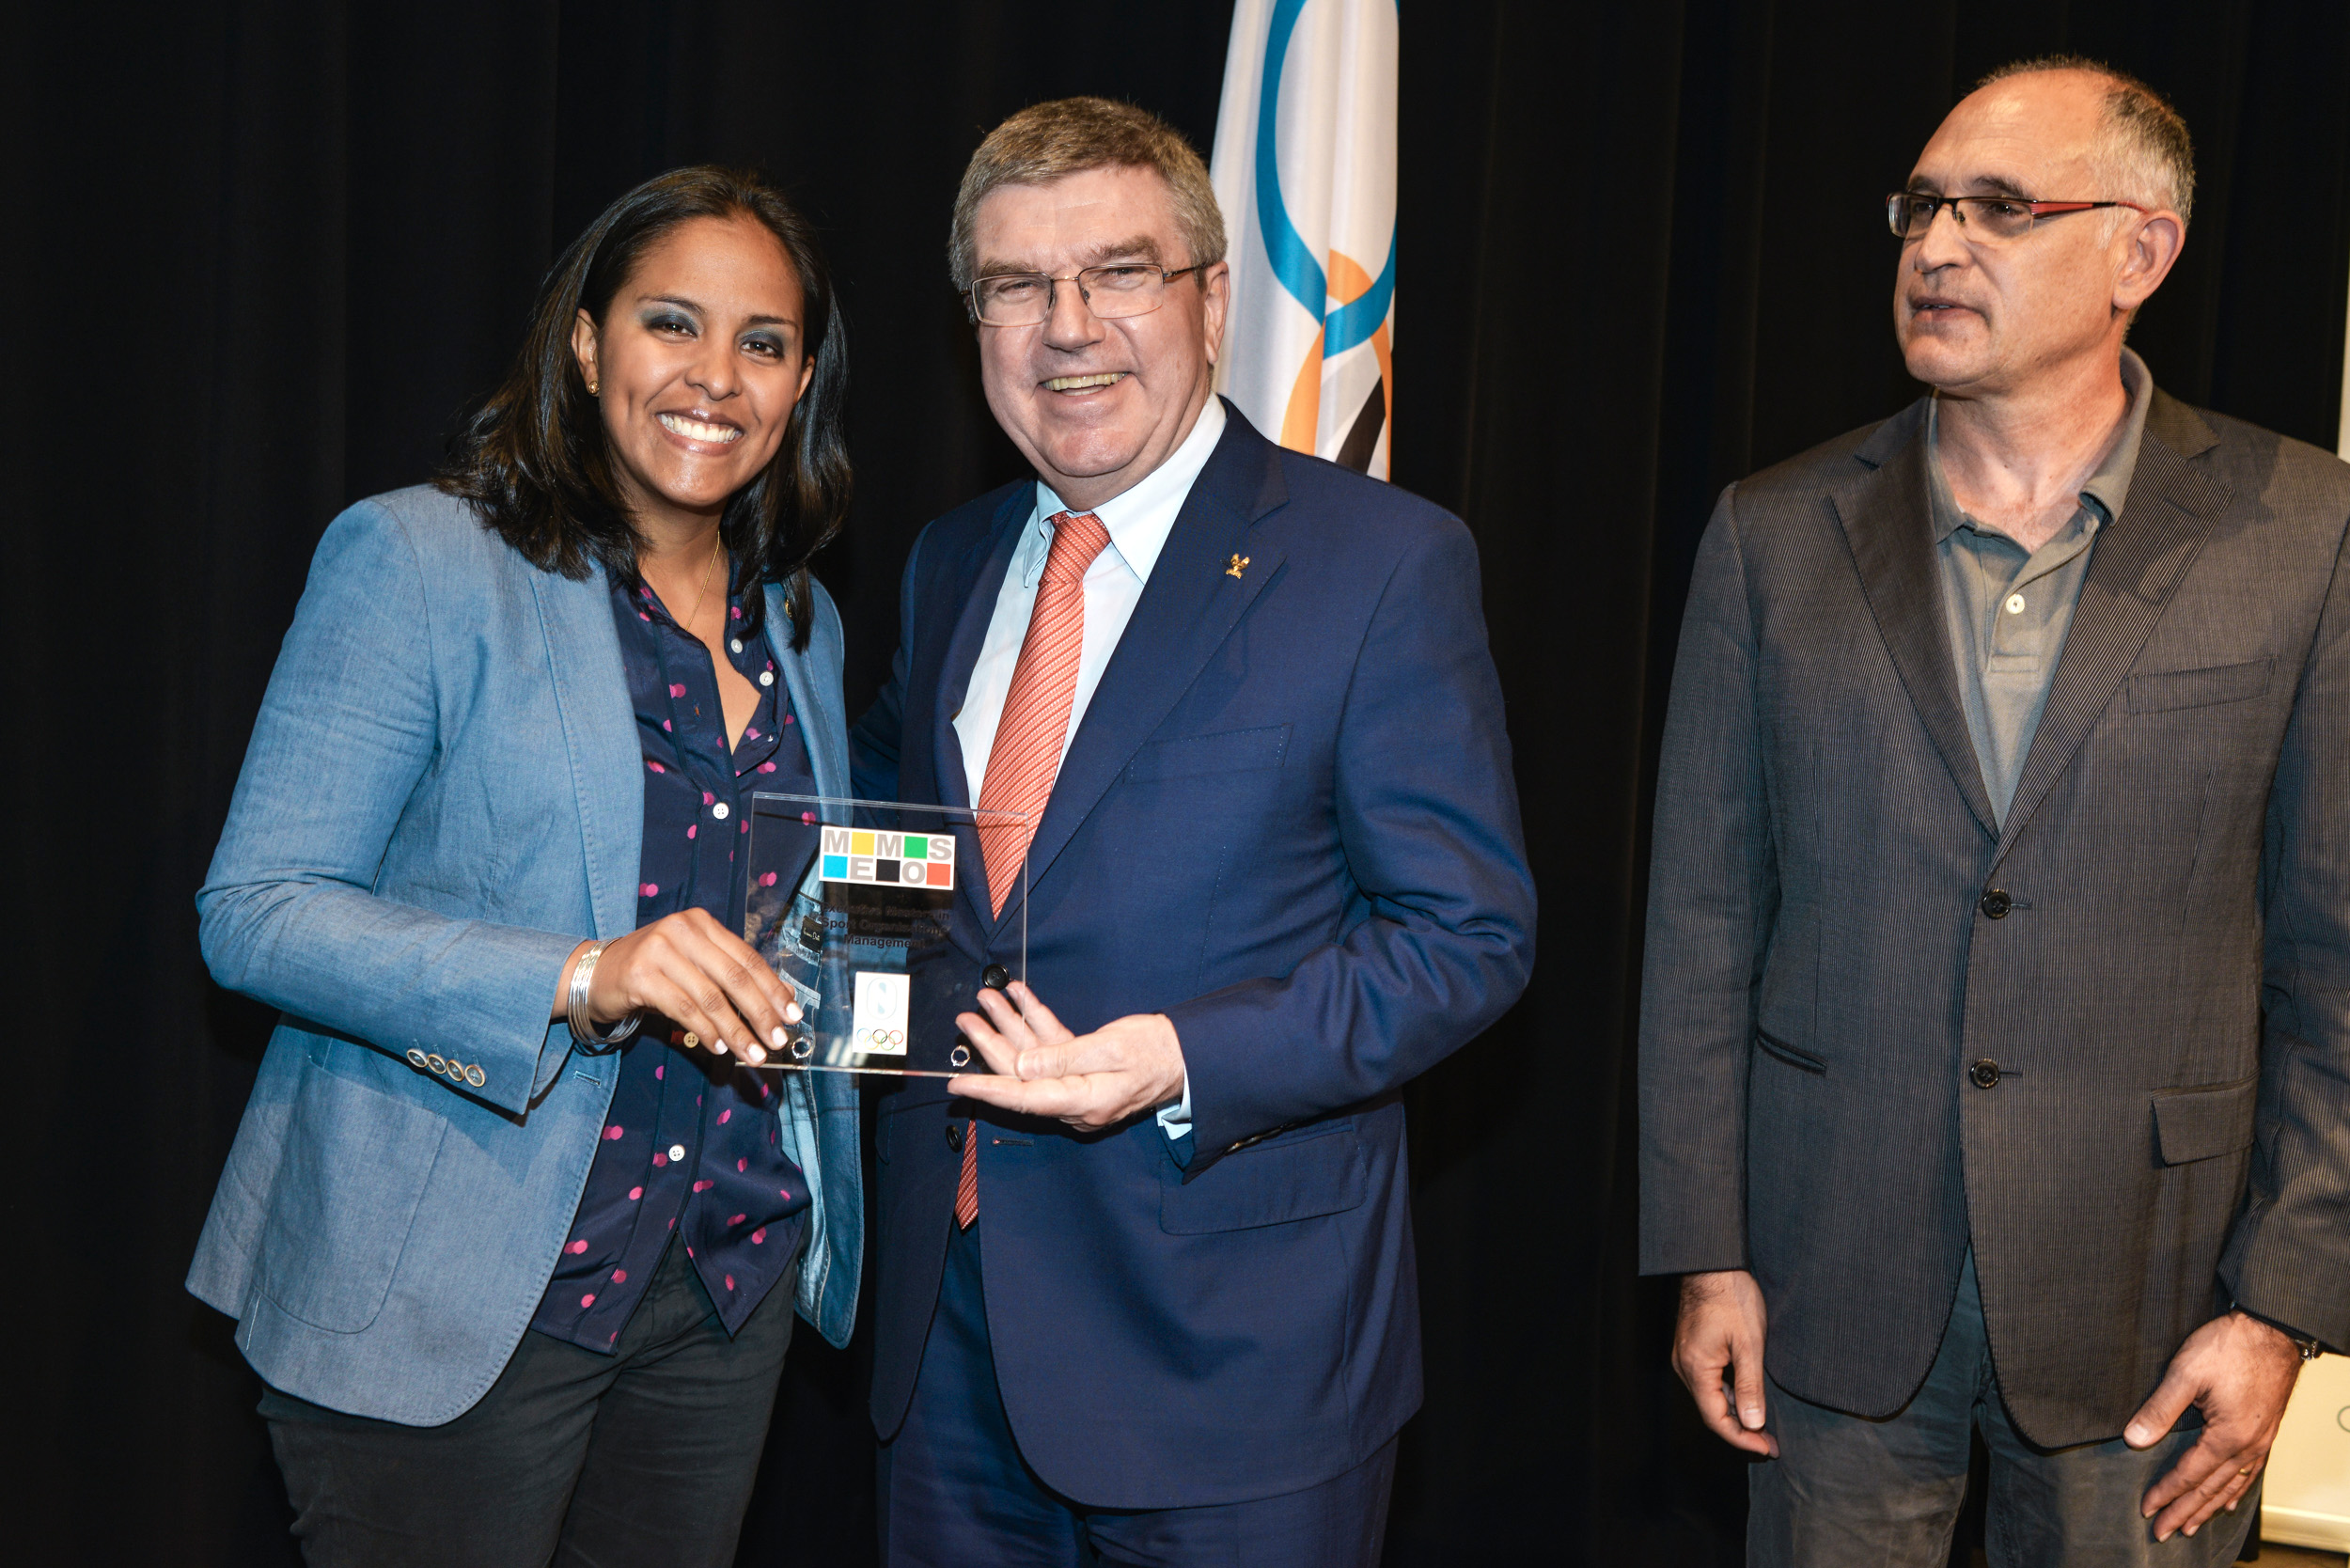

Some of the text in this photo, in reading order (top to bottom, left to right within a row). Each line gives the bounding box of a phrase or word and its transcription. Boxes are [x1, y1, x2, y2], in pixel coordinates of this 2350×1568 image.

[938, 909, 949, 920] in
[822, 917, 854, 931] Sport
[844, 933, 926, 949] Management
